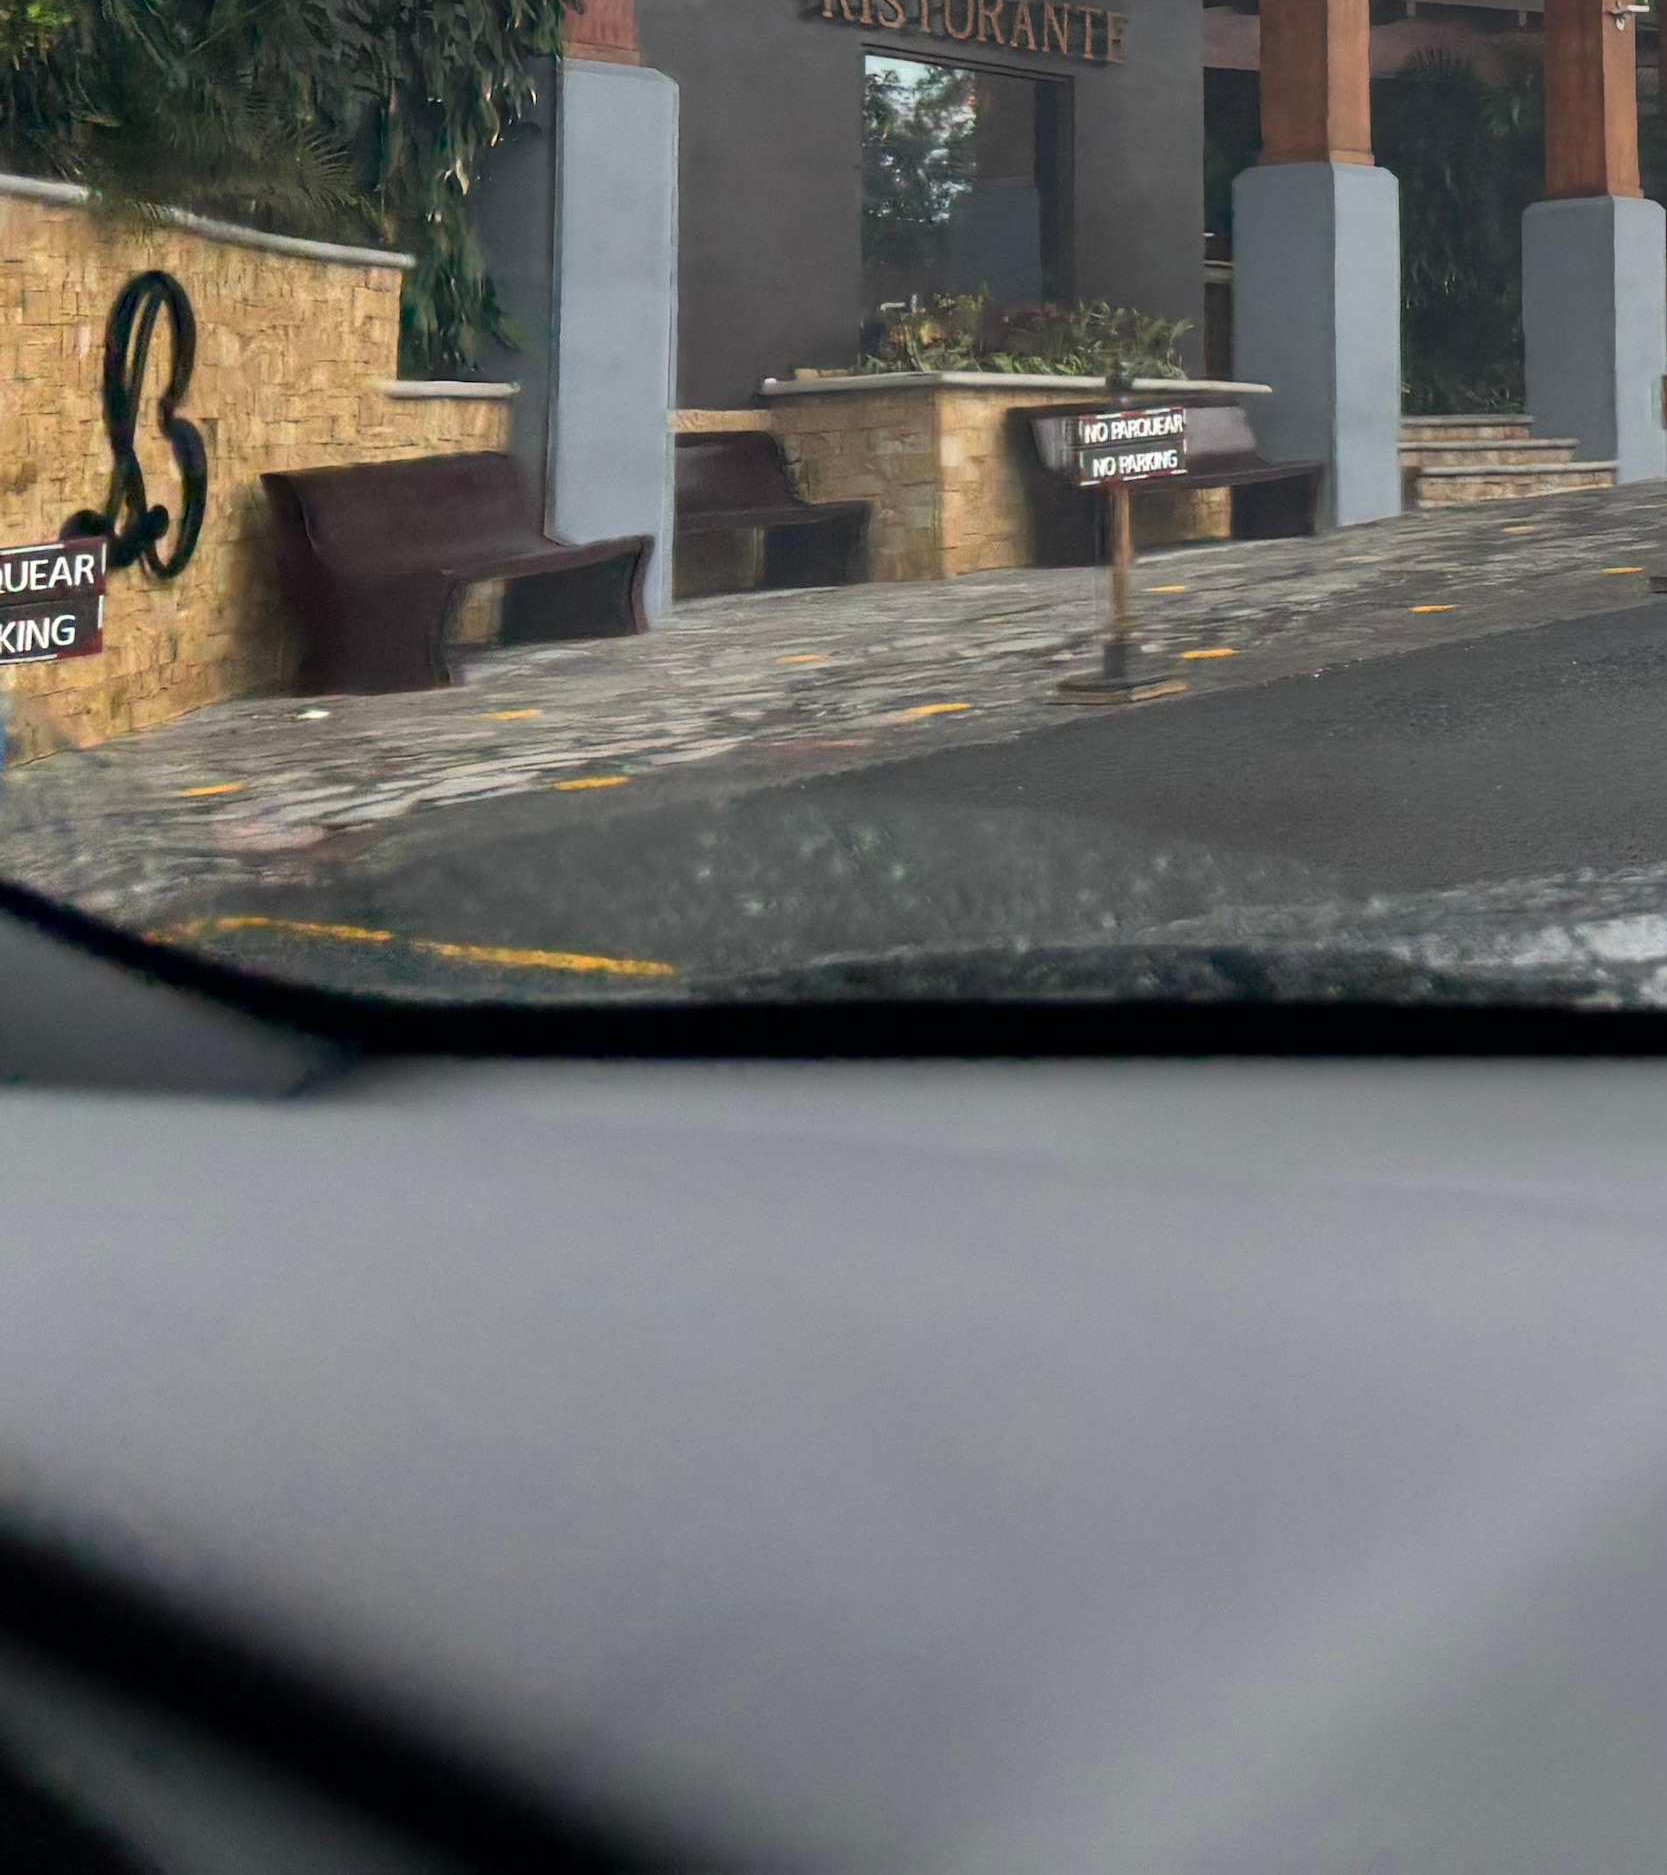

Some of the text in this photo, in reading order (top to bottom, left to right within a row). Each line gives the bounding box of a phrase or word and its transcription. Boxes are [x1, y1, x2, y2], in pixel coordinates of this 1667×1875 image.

[1085, 414, 1183, 443] NO PARQUEAR
[1093, 449, 1178, 477] NO PARKING
